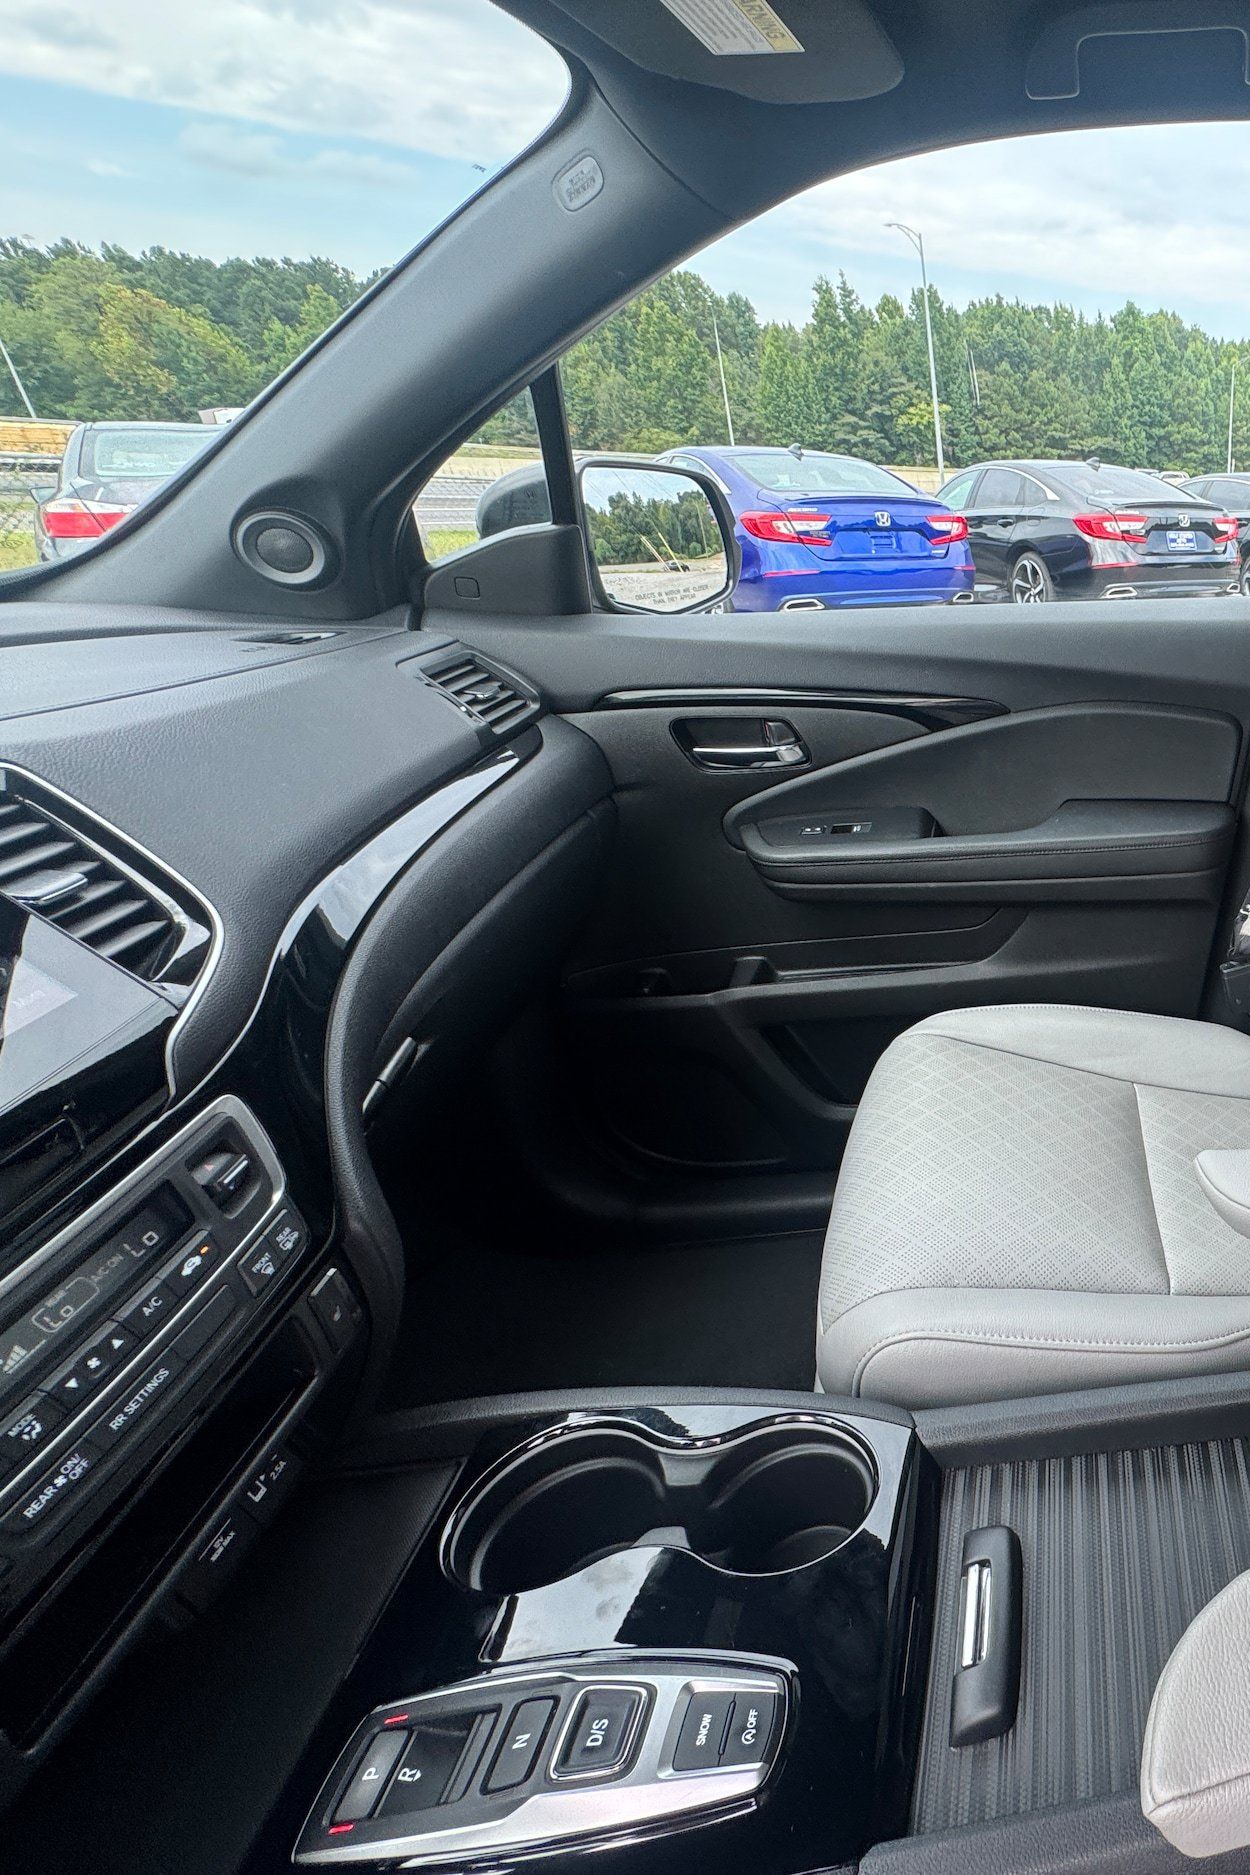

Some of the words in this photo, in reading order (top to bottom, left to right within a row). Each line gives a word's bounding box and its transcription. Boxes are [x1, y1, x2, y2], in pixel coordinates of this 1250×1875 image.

[252, 1252, 271, 1273] FRONT
[142, 1296, 163, 1317] A/C
[109, 1413, 128, 1431] RR
[123, 1368, 170, 1415] SETTINGS
[7, 1413, 36, 1438] MODE
[69, 1458, 89, 1480] OFF
[23, 1485, 59, 1519] REAR
[746, 1708, 758, 1729] OFF
[586, 1718, 609, 1747] D/S
[695, 1713, 712, 1746] SNOW
[512, 1733, 531, 1750] N
[362, 1767, 379, 1781] P
[398, 1767, 418, 1781] R
